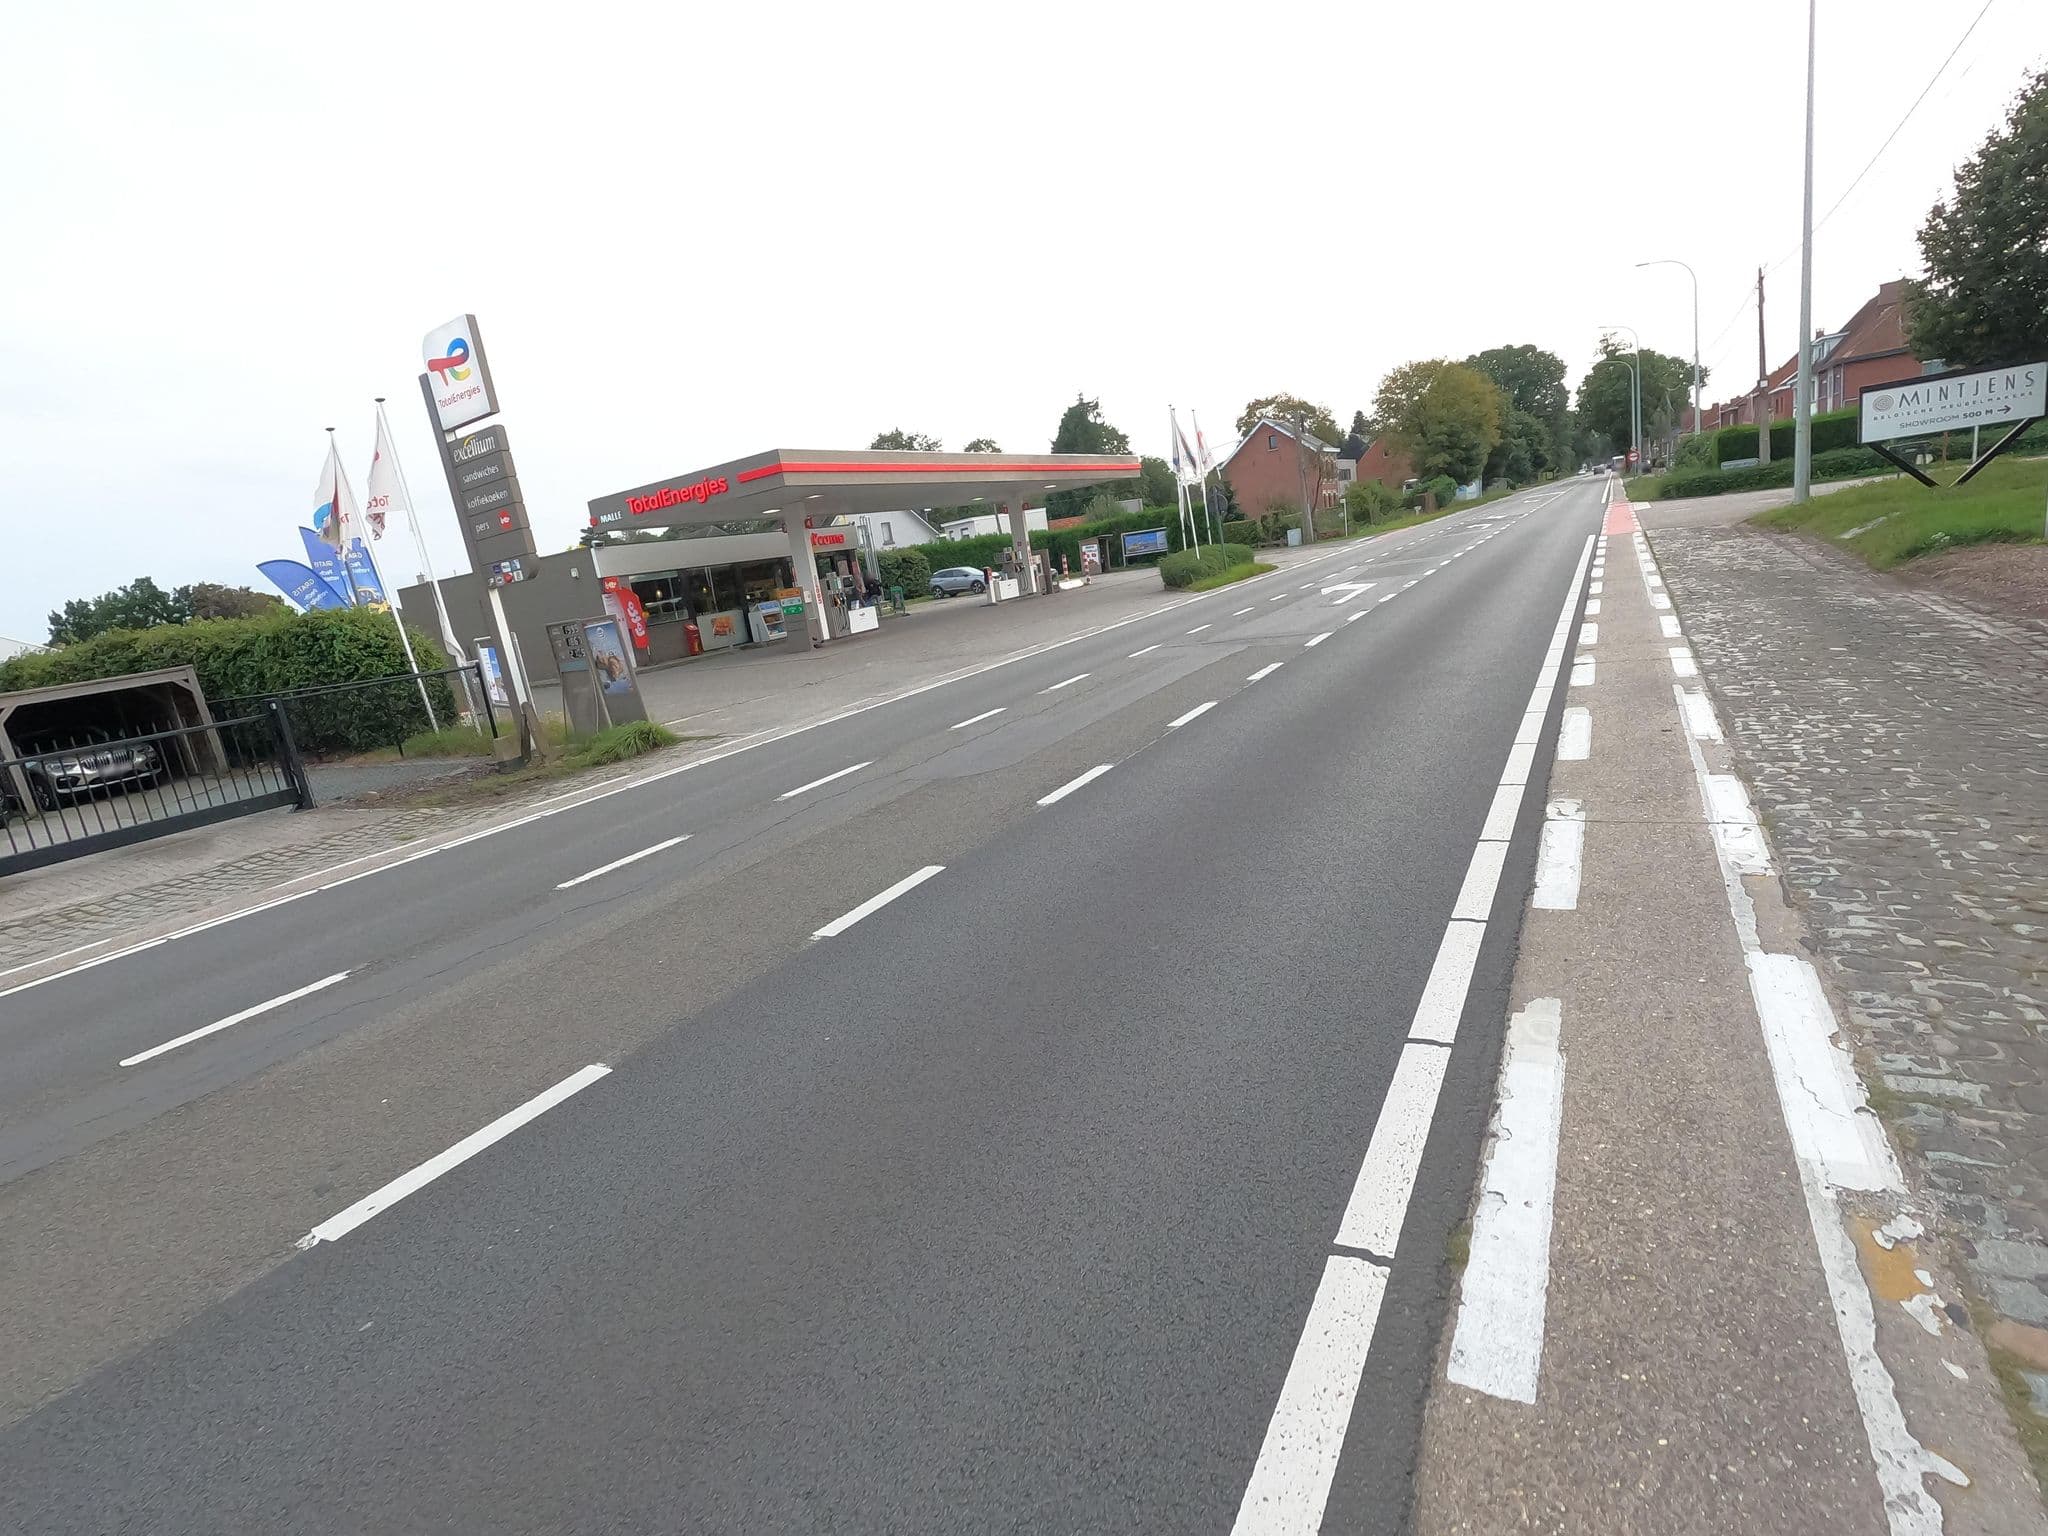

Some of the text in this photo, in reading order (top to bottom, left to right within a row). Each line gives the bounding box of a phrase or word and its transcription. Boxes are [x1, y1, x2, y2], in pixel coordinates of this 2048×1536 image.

[438, 385, 481, 408] TotalEnergies
[1899, 370, 2034, 408] MINTJENS
[1900, 413, 1959, 429] SHOWROOM
[1963, 410, 1982, 420] 500
[453, 436, 495, 463] excellium
[462, 464, 499, 484] sandwiches
[466, 490, 509, 509] koffiekoeken
[625, 477, 728, 515] TotalEnergies
[475, 521, 490, 533] pers
[600, 510, 622, 524] MALLE
